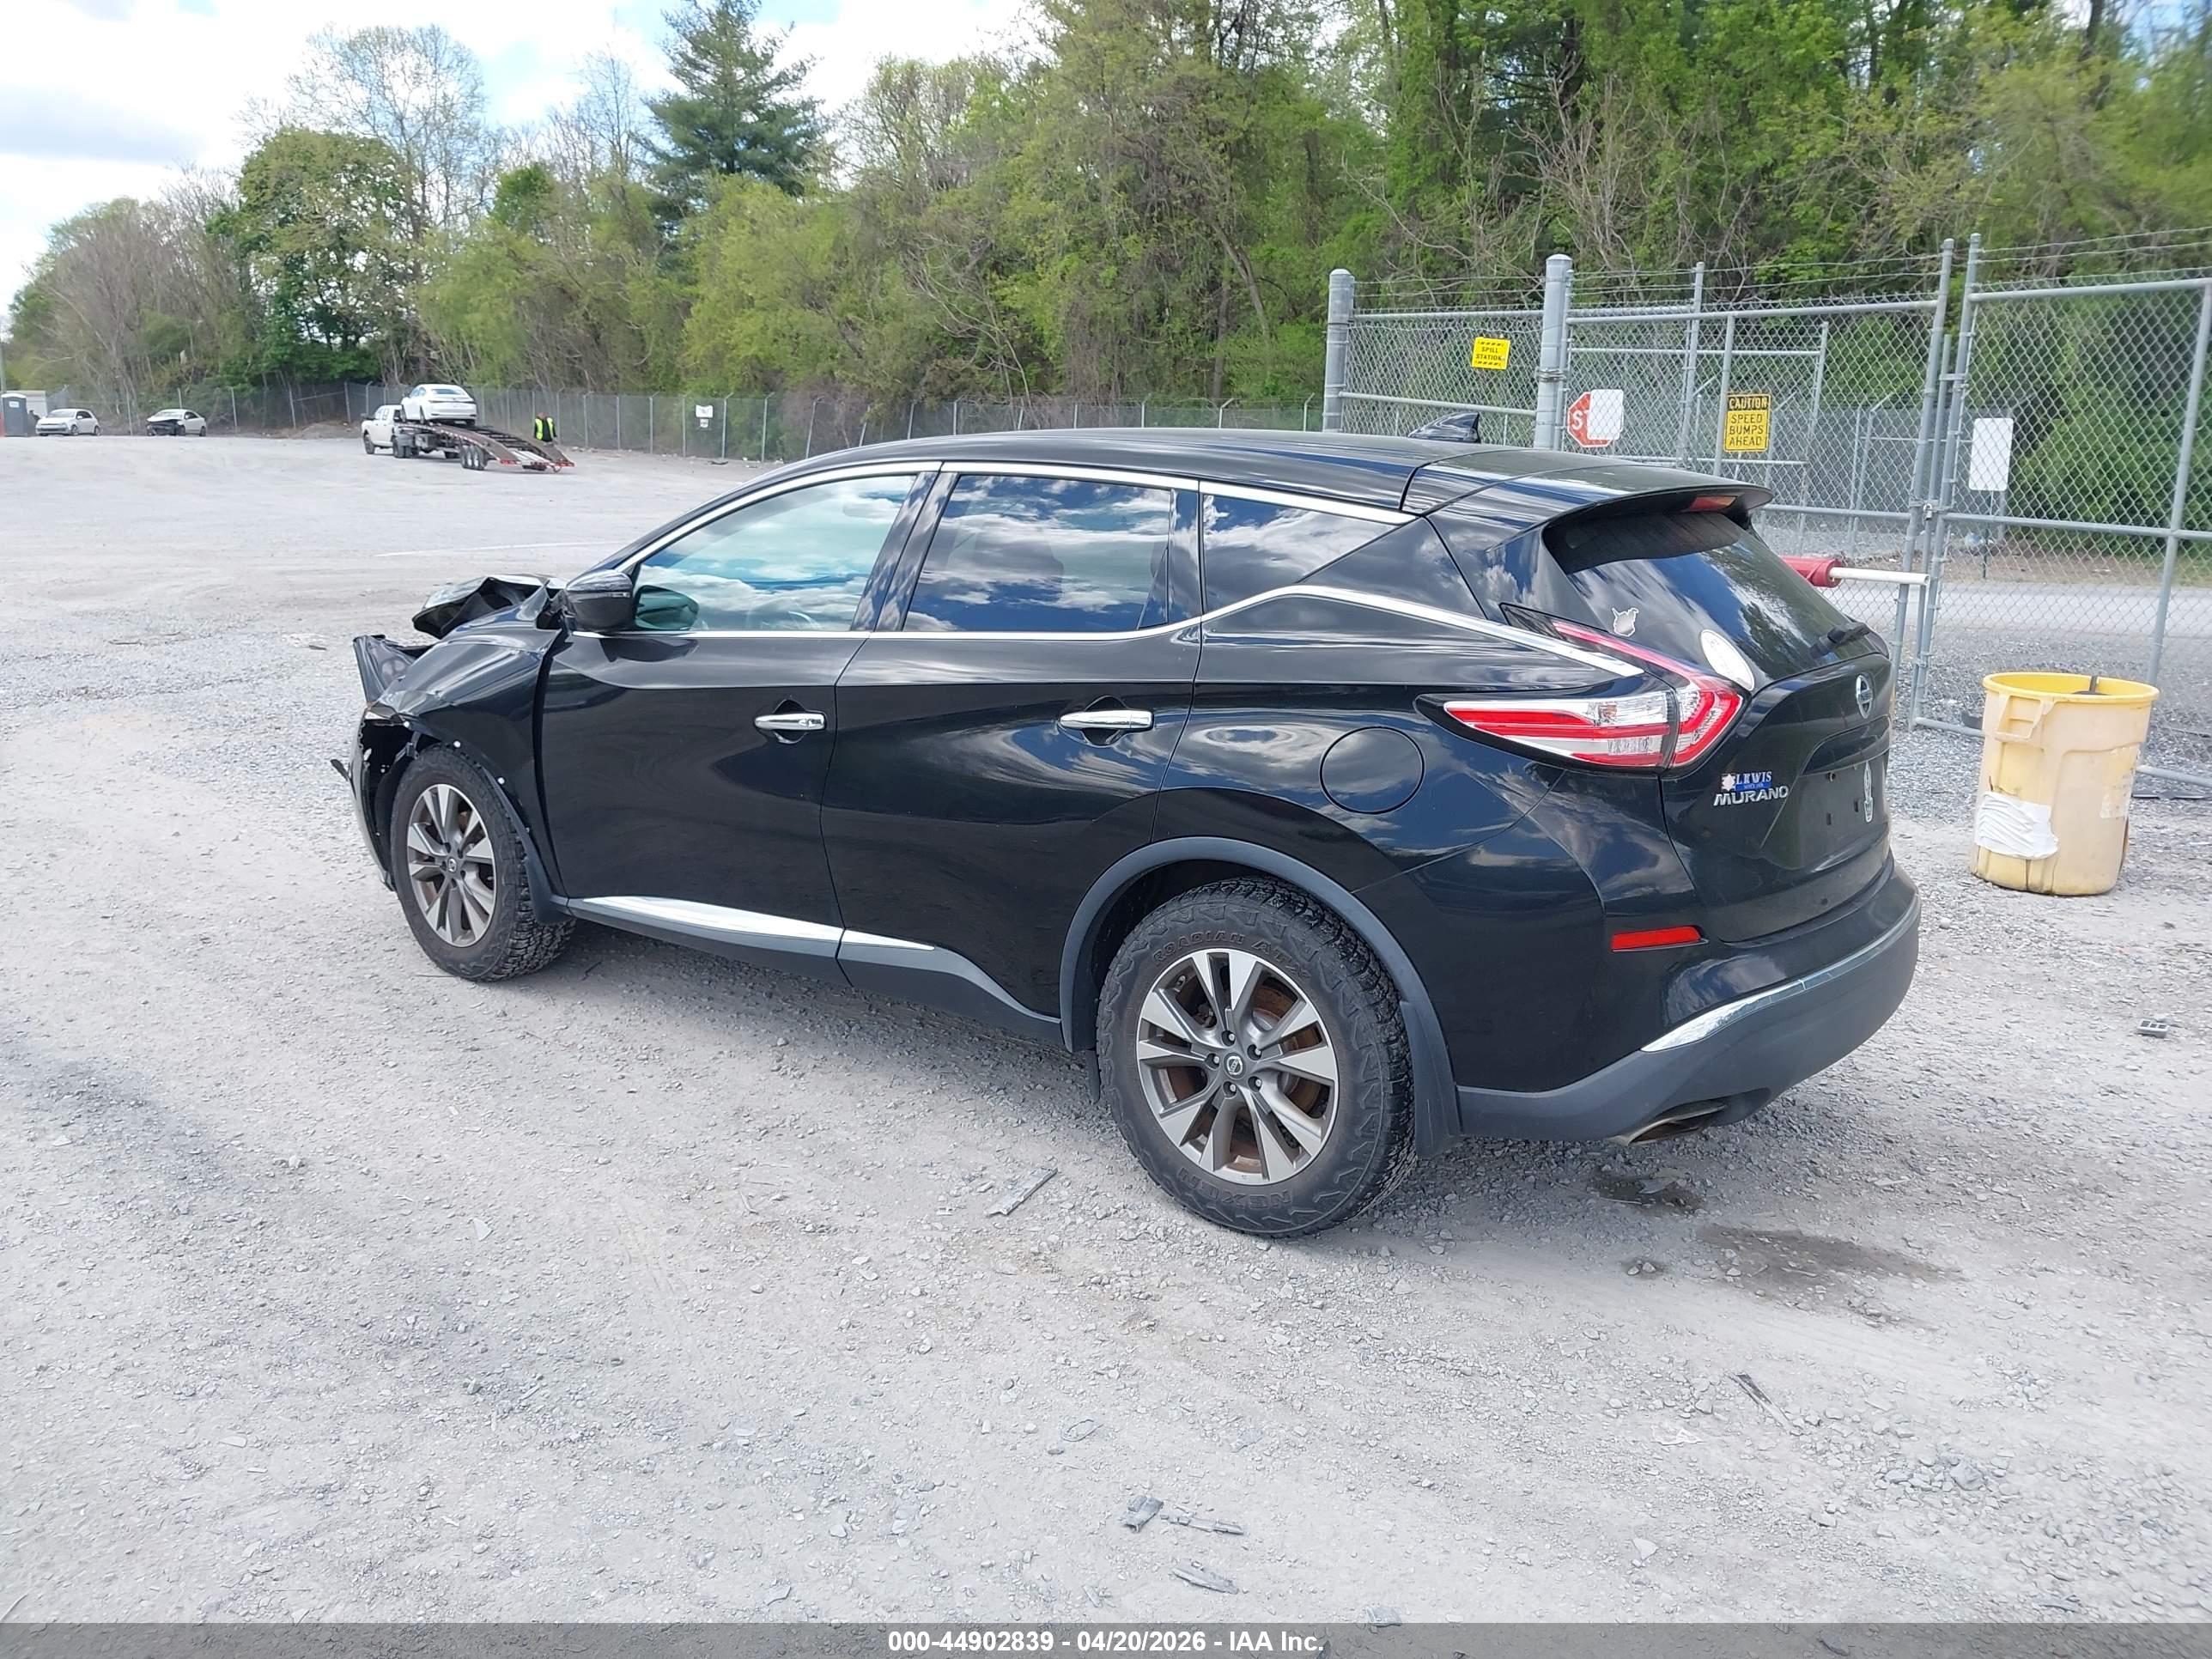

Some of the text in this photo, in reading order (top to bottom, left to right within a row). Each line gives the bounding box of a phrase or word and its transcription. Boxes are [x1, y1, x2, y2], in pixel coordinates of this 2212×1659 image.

[1729, 397, 1768, 410] CAUTION
[1730, 413, 1763, 424] SPEED
[1729, 425, 1764, 435] BUMPS
[1729, 436, 1762, 447] AHEAD
[1713, 785, 1789, 806] MURANO
[1152, 930, 1246, 965] ROADIAN
